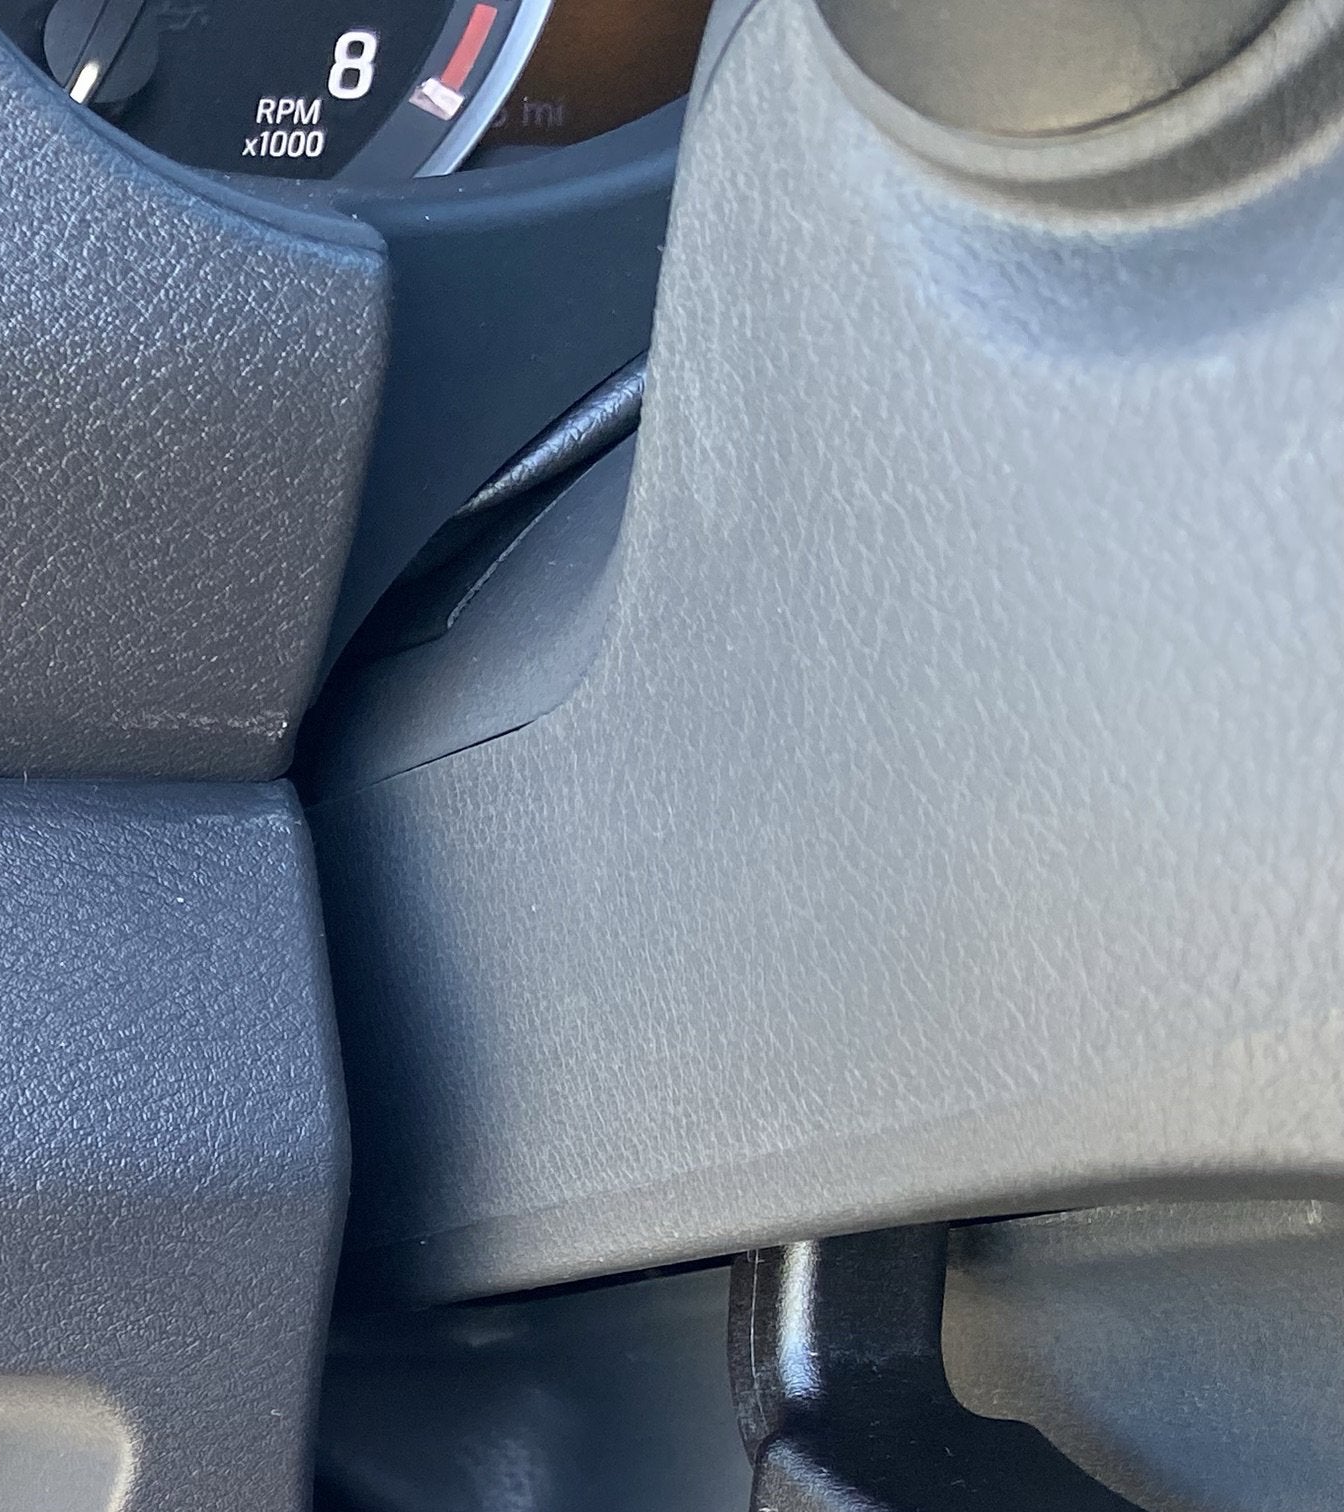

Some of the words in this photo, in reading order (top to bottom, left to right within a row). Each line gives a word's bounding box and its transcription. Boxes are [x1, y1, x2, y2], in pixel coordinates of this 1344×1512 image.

[327, 30, 378, 100] 8
[255, 98, 322, 125] RPM
[241, 130, 325, 158] x1000
